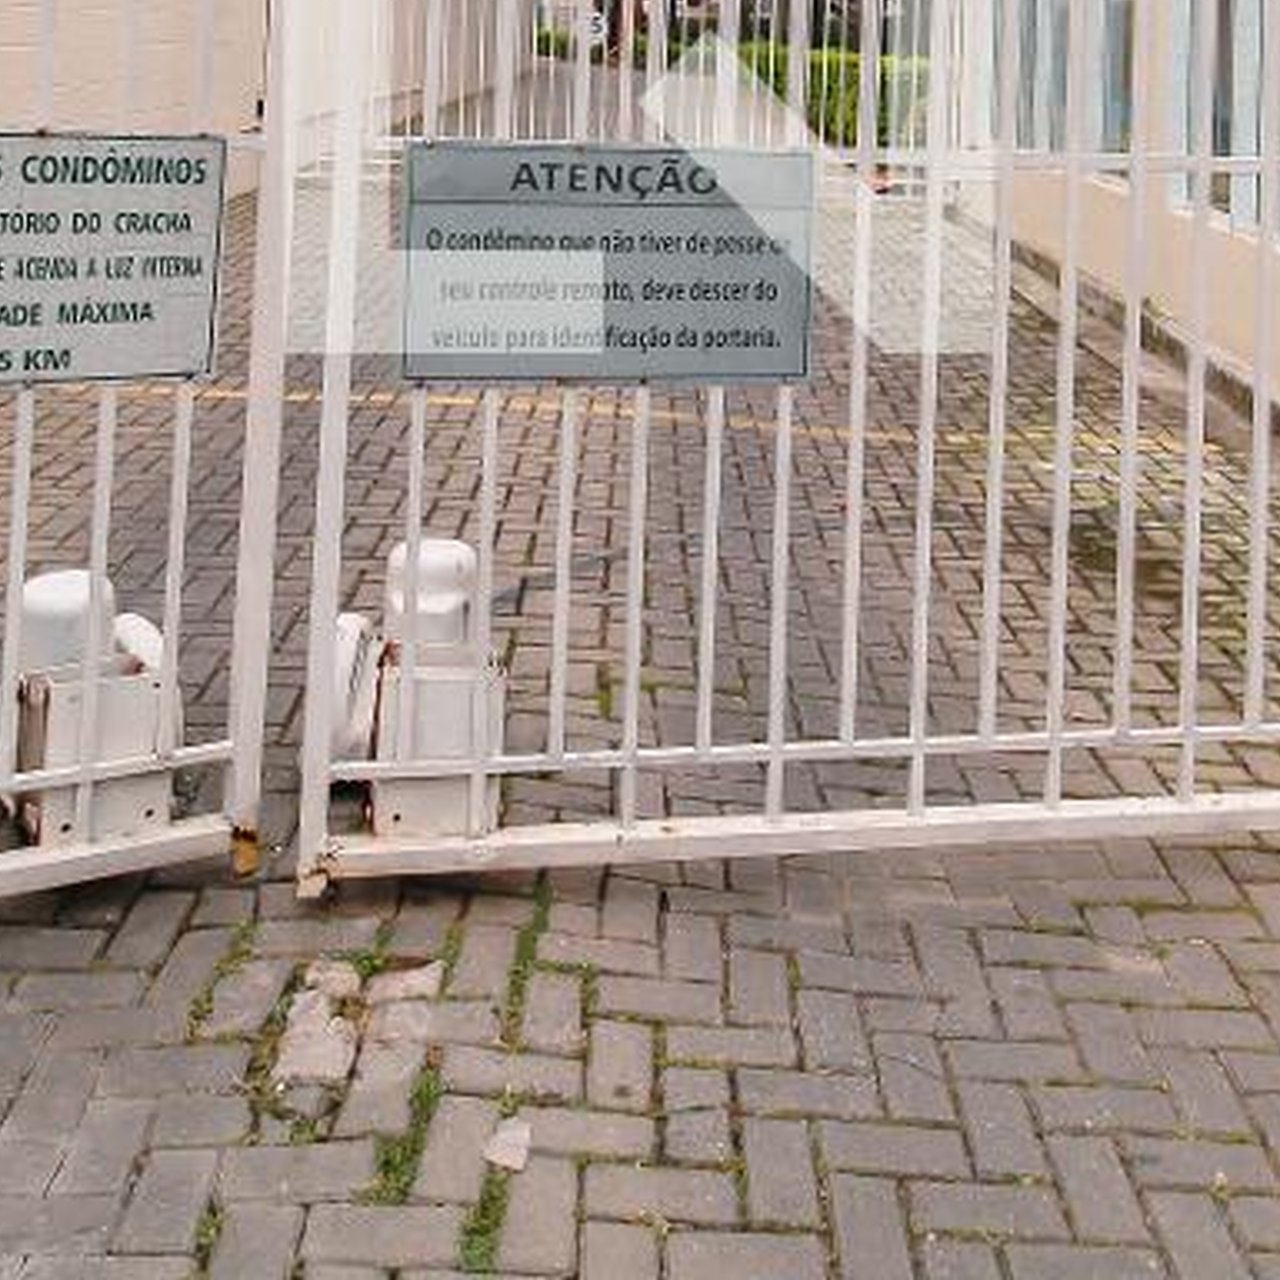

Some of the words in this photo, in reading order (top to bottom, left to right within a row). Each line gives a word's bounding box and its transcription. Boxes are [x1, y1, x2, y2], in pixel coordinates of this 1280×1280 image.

[21, 147, 207, 185] CONDÔMINOS
[510, 158, 718, 200] ATENÇÃO
[72, 212, 102, 235] DO
[426, 227, 443, 251] O
[560, 234, 596, 258] que
[600, 229, 635, 255] não
[639, 229, 682, 255] tiver
[685, 230, 710, 255] de
[713, 234, 766, 258] posse
[14, 256, 78, 281] ACENDA
[87, 257, 97, 279] A
[105, 255, 135, 280] LUZ
[142, 255, 203, 279] INTERNA
[641, 278, 686, 302] deve
[689, 277, 749, 302] descer
[753, 277, 779, 302] do
[57, 295, 157, 325] MÁXIMA
[675, 322, 698, 348] da
[703, 326, 781, 353] portaria.
[23, 348, 72, 373] KM
